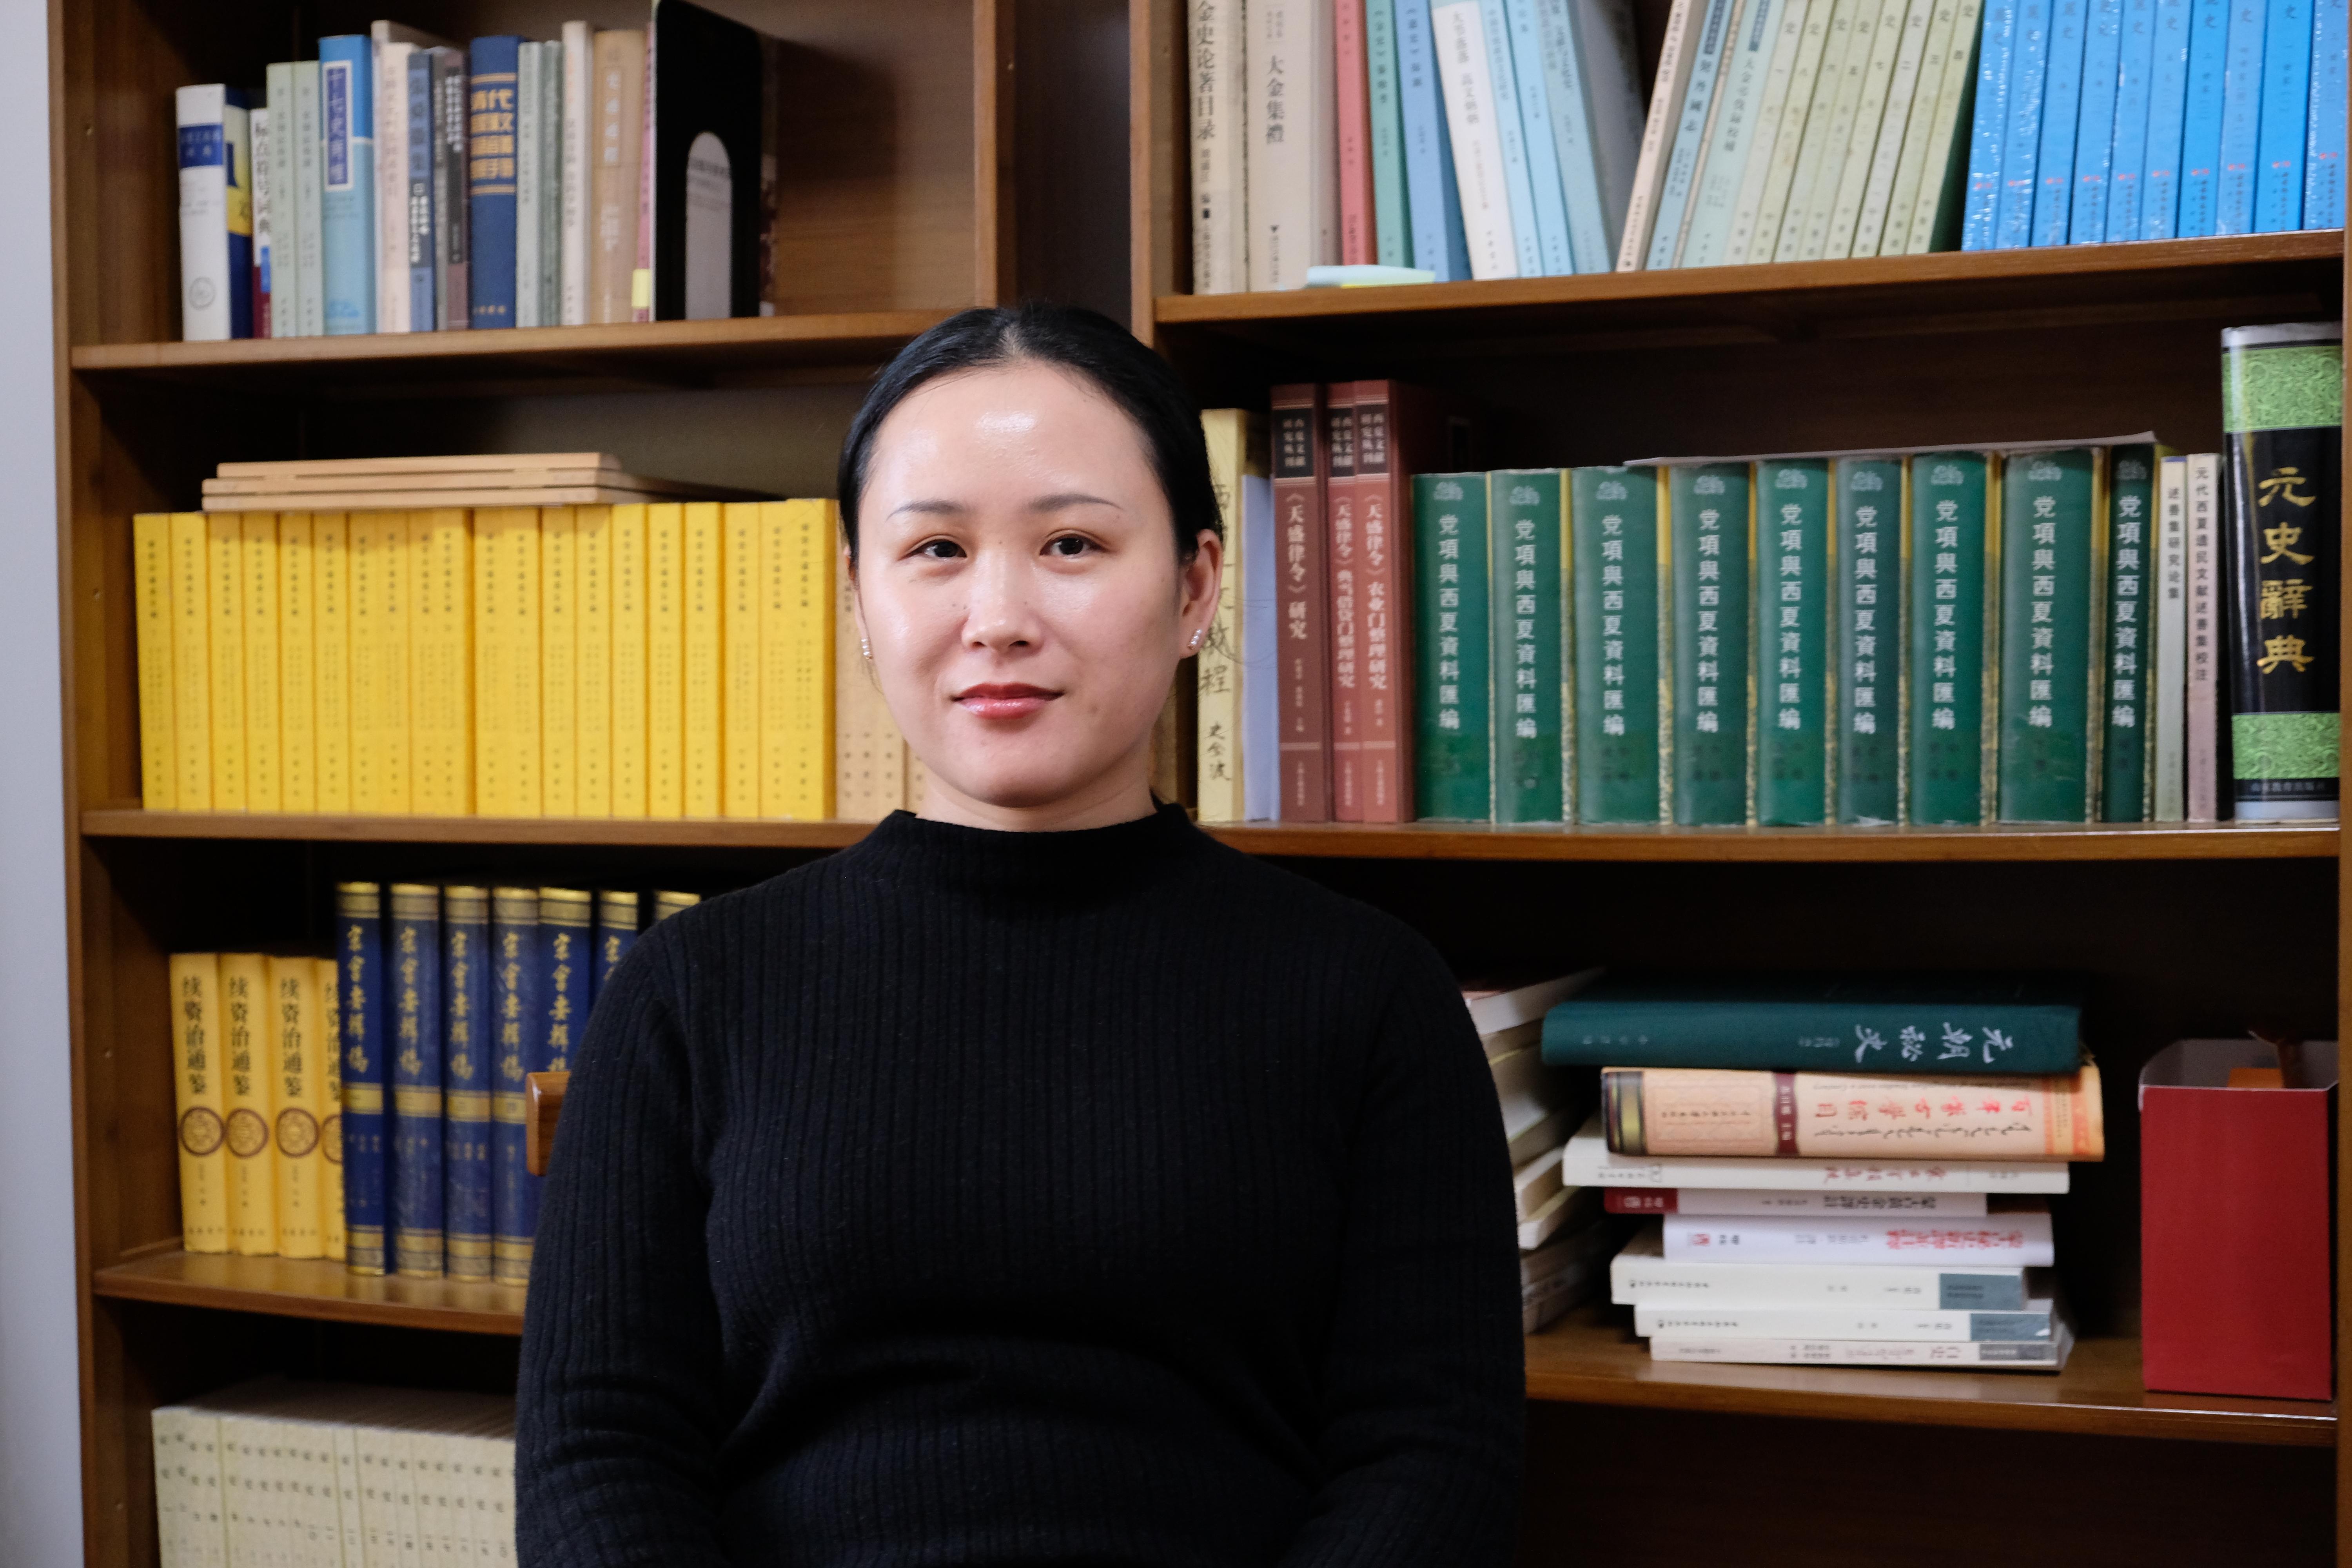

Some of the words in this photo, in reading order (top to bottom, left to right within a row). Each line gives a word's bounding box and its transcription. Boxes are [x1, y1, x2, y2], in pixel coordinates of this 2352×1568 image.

[1266, 54, 1284, 145] 大金集禮
[2257, 466, 2317, 675] 元史辭典
[1855, 1022, 2014, 1063] 元朝秘史
